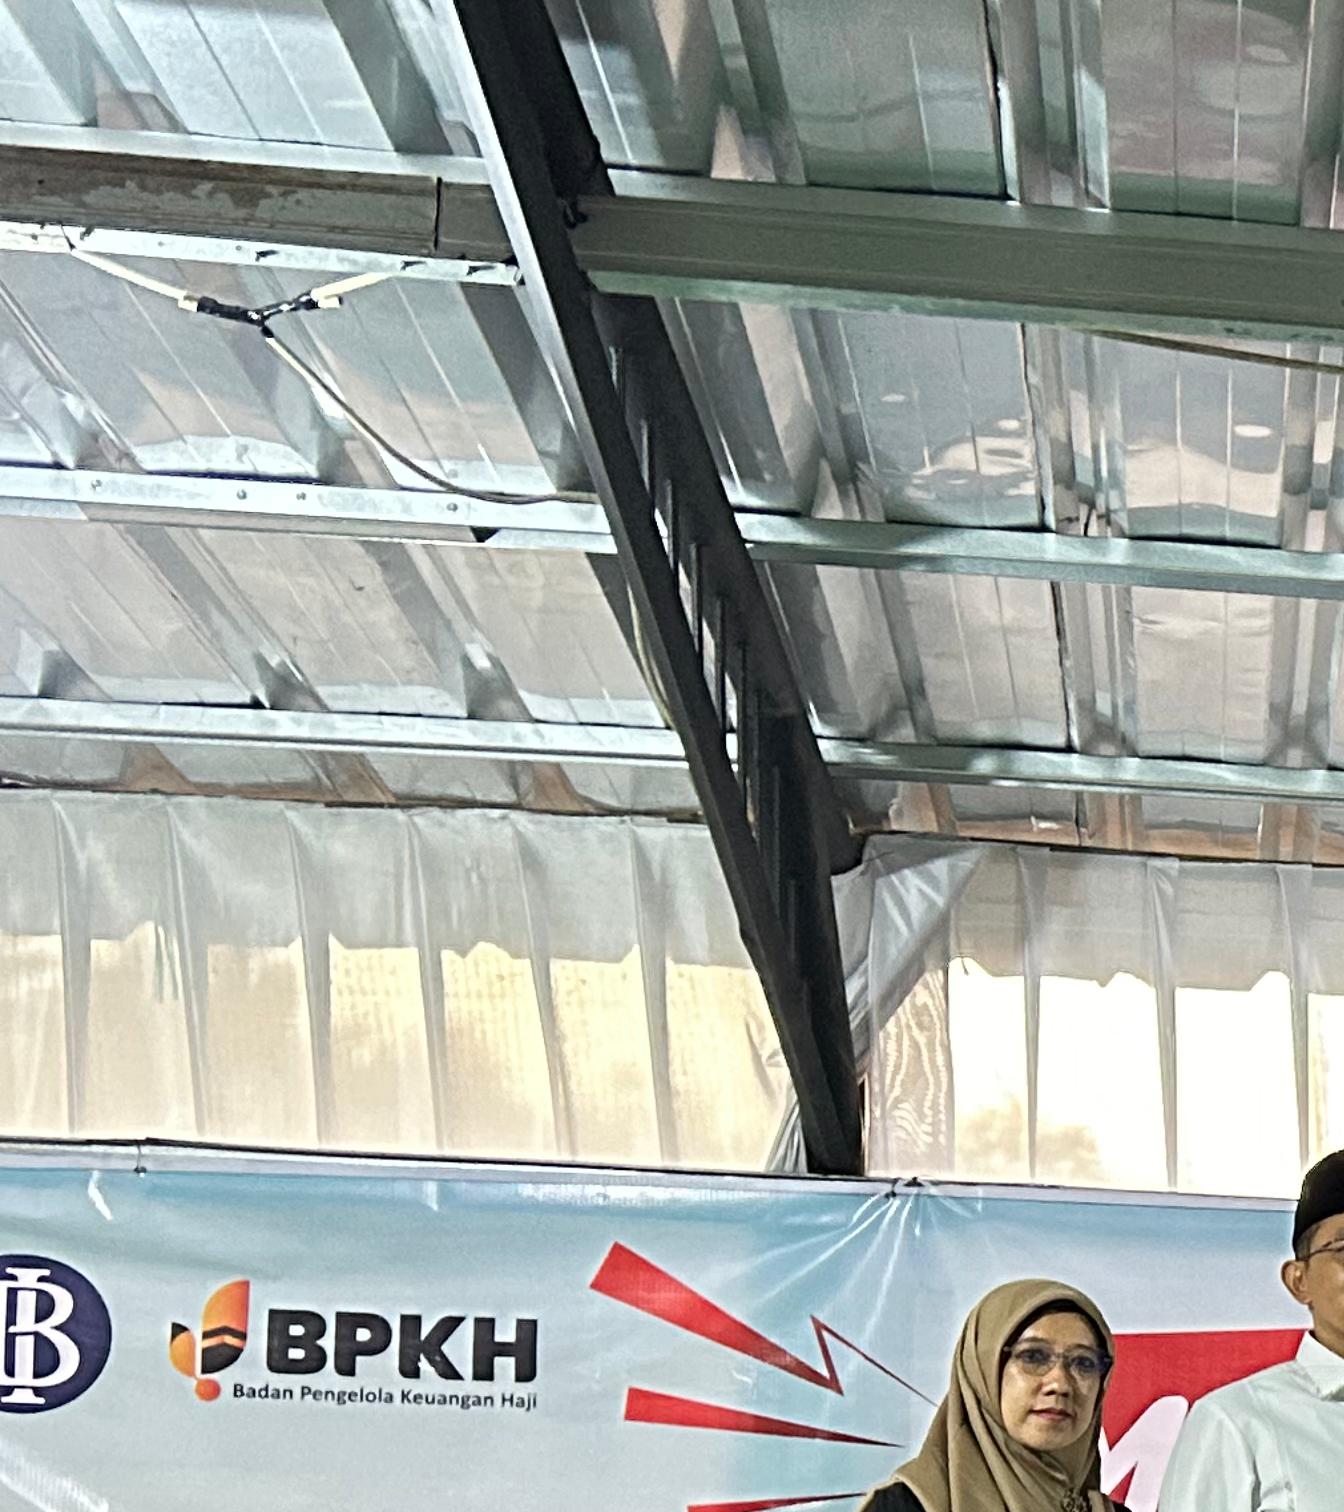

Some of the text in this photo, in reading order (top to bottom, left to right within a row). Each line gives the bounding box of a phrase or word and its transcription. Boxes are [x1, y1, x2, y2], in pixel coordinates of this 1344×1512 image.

[266, 1308, 538, 1383] BPKH
[233, 1383, 538, 1410] Badan Pengelola Keuangan Haji
